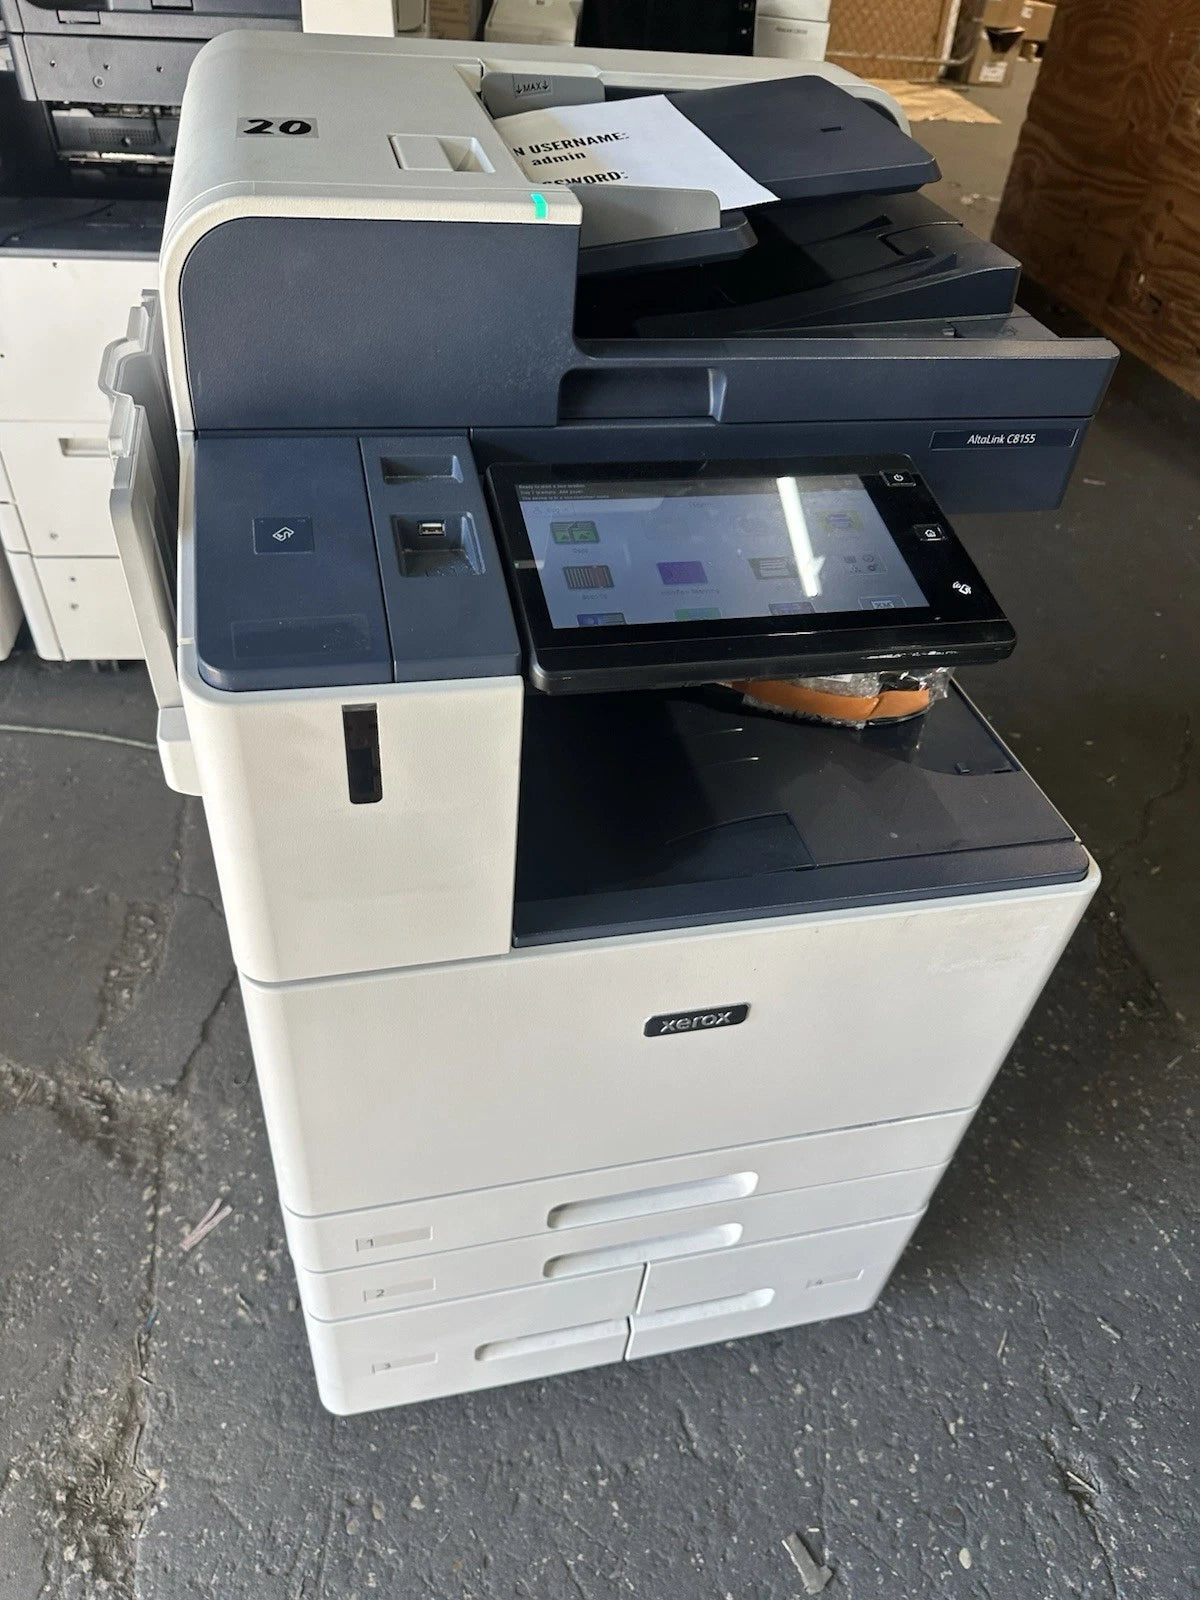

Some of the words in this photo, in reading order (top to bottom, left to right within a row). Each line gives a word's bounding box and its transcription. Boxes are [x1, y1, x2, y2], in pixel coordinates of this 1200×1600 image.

[523, 82, 541, 92] MAX
[243, 119, 312, 135] 20
[528, 132, 630, 153] USERNAME:
[531, 152, 586, 166] admin
[542, 171, 629, 184] SWORD:
[967, 434, 1004, 444] AltaLink
[1006, 433, 1036, 444] C8155
[660, 1011, 732, 1033] xerox
[376, 1289, 384, 1298] 2
